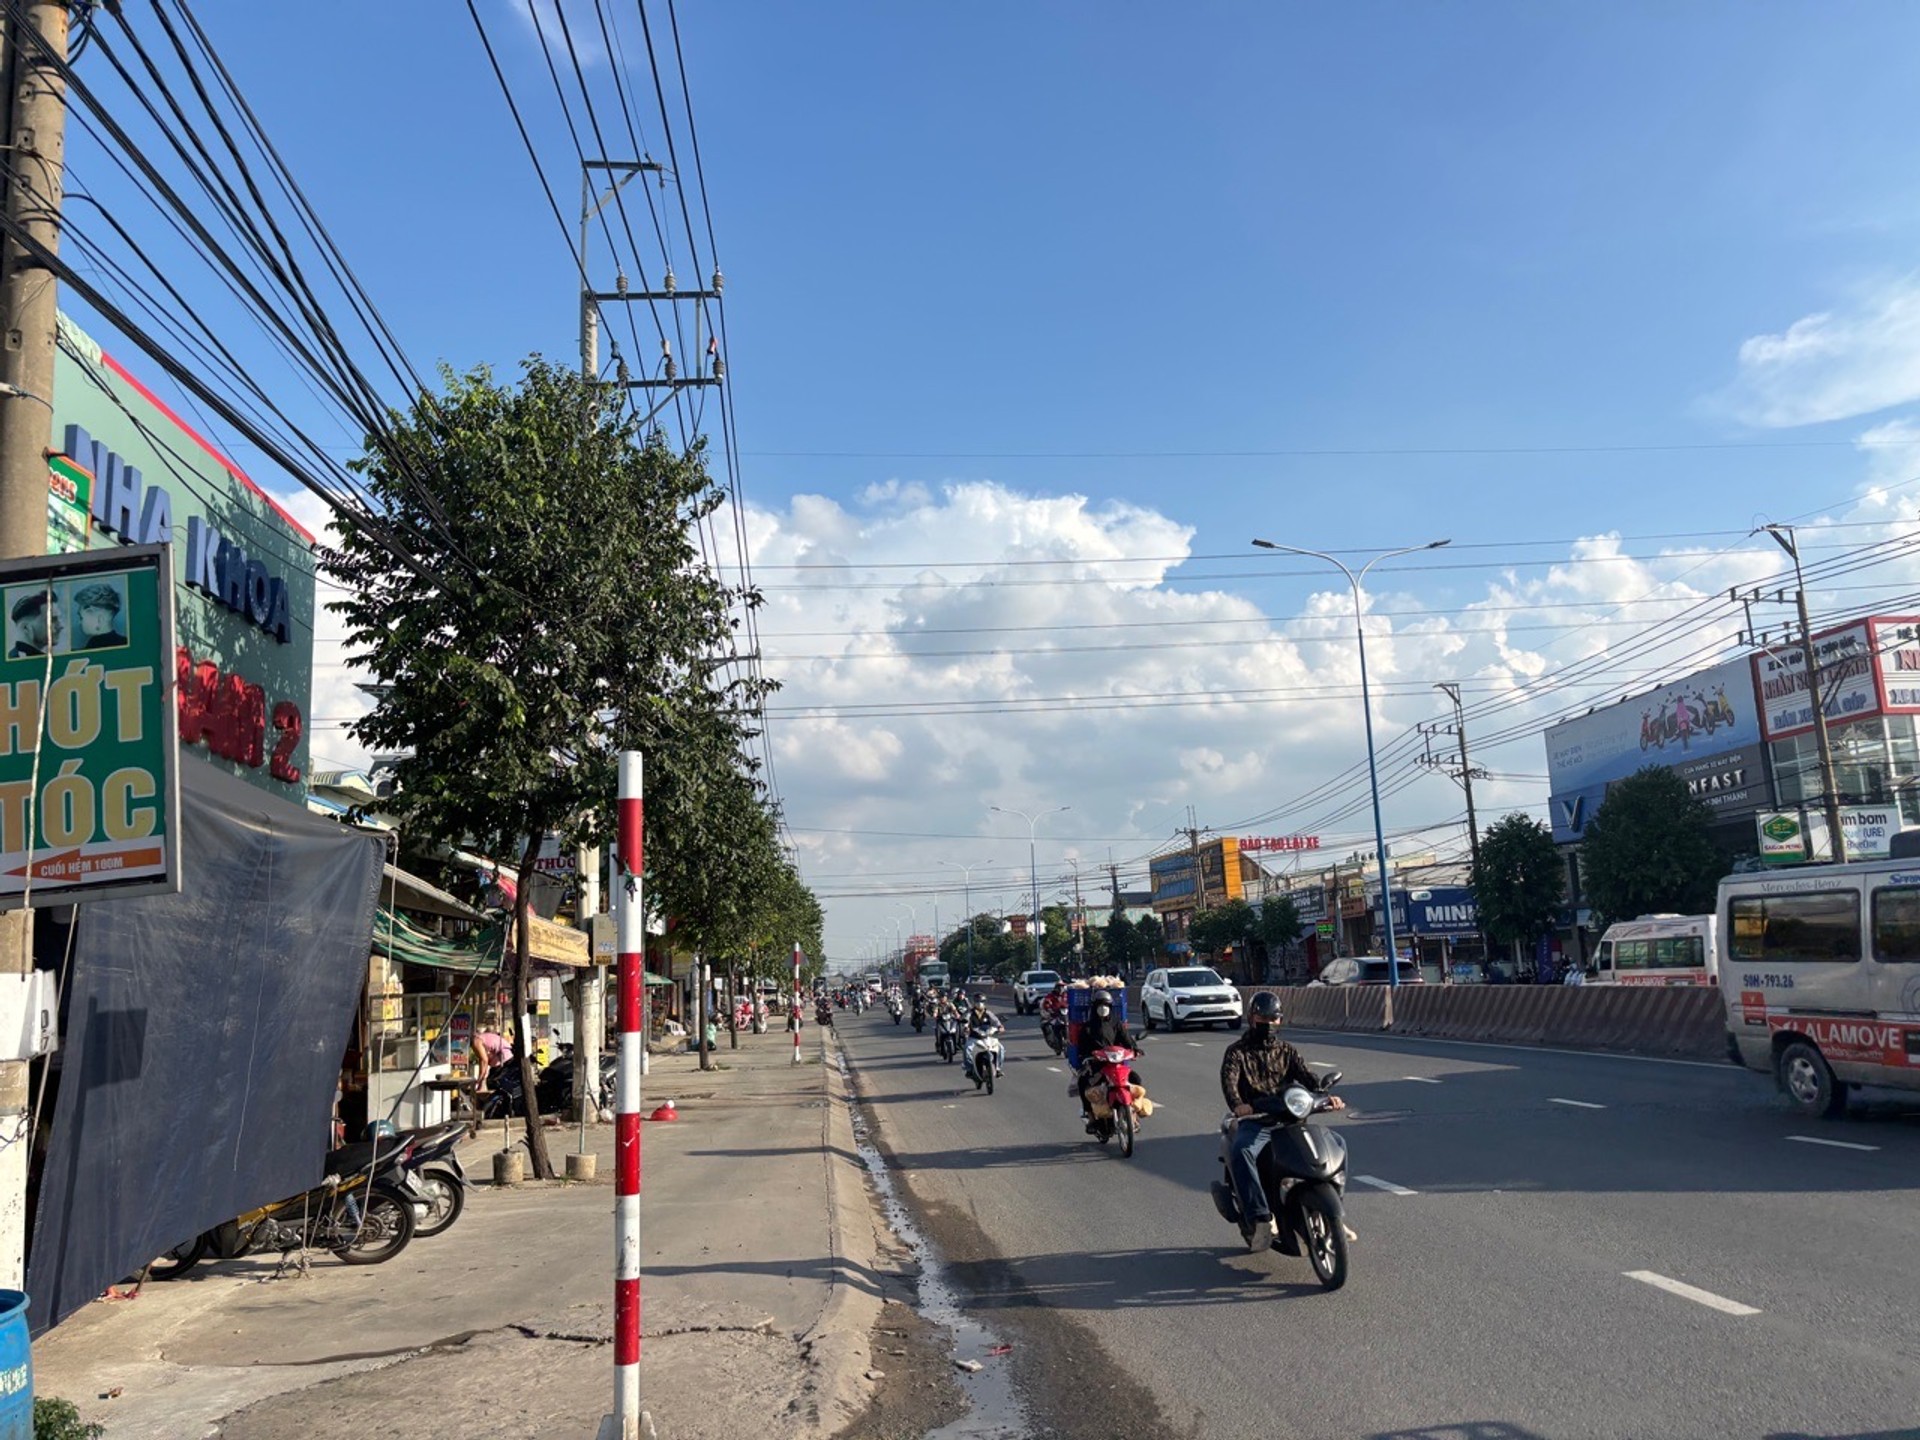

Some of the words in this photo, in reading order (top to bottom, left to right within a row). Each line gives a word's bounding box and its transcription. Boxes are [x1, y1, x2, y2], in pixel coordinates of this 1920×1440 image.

[65, 424, 172, 545] NHA
[185, 515, 291, 643] KHOA
[0, 657, 154, 754] HỚT
[270, 701, 302, 783] 2
[0, 758, 157, 851] TÓC
[1688, 769, 1743, 796] NFAST
[41, 858, 66, 877] CUỐI
[1761, 879, 1842, 893] Mercedes-Benz
